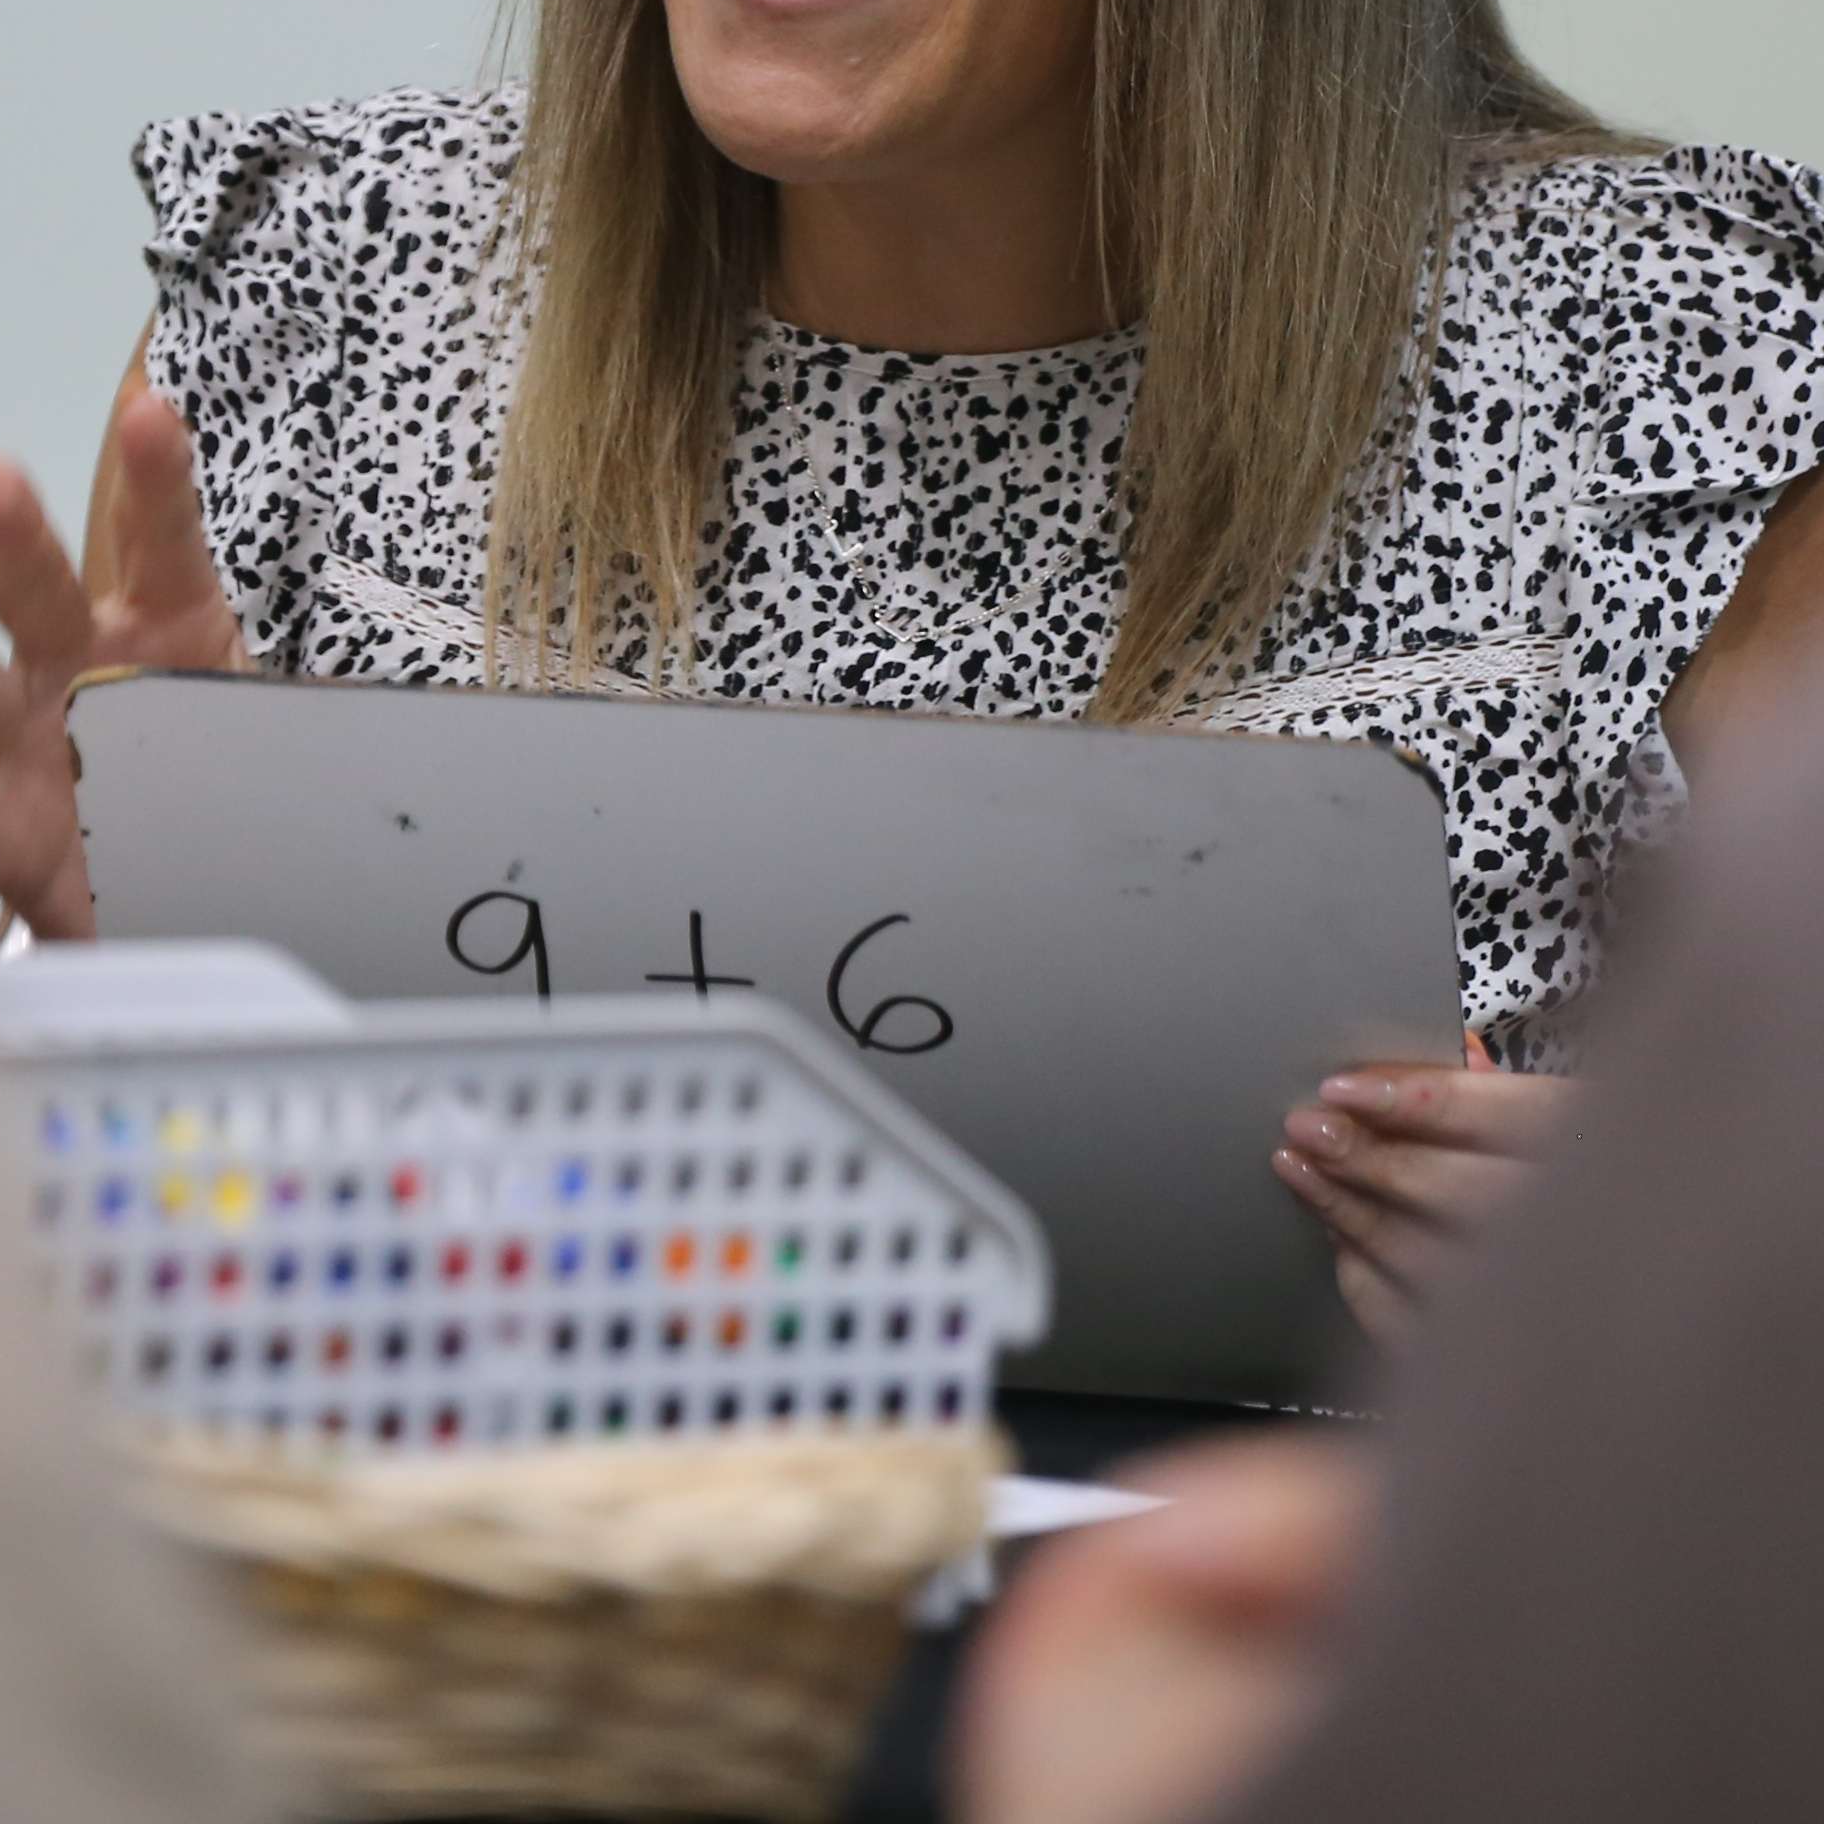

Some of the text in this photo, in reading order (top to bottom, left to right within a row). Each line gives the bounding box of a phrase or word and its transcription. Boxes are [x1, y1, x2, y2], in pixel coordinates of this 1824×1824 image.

[446, 890, 954, 1054] 9 + 6
